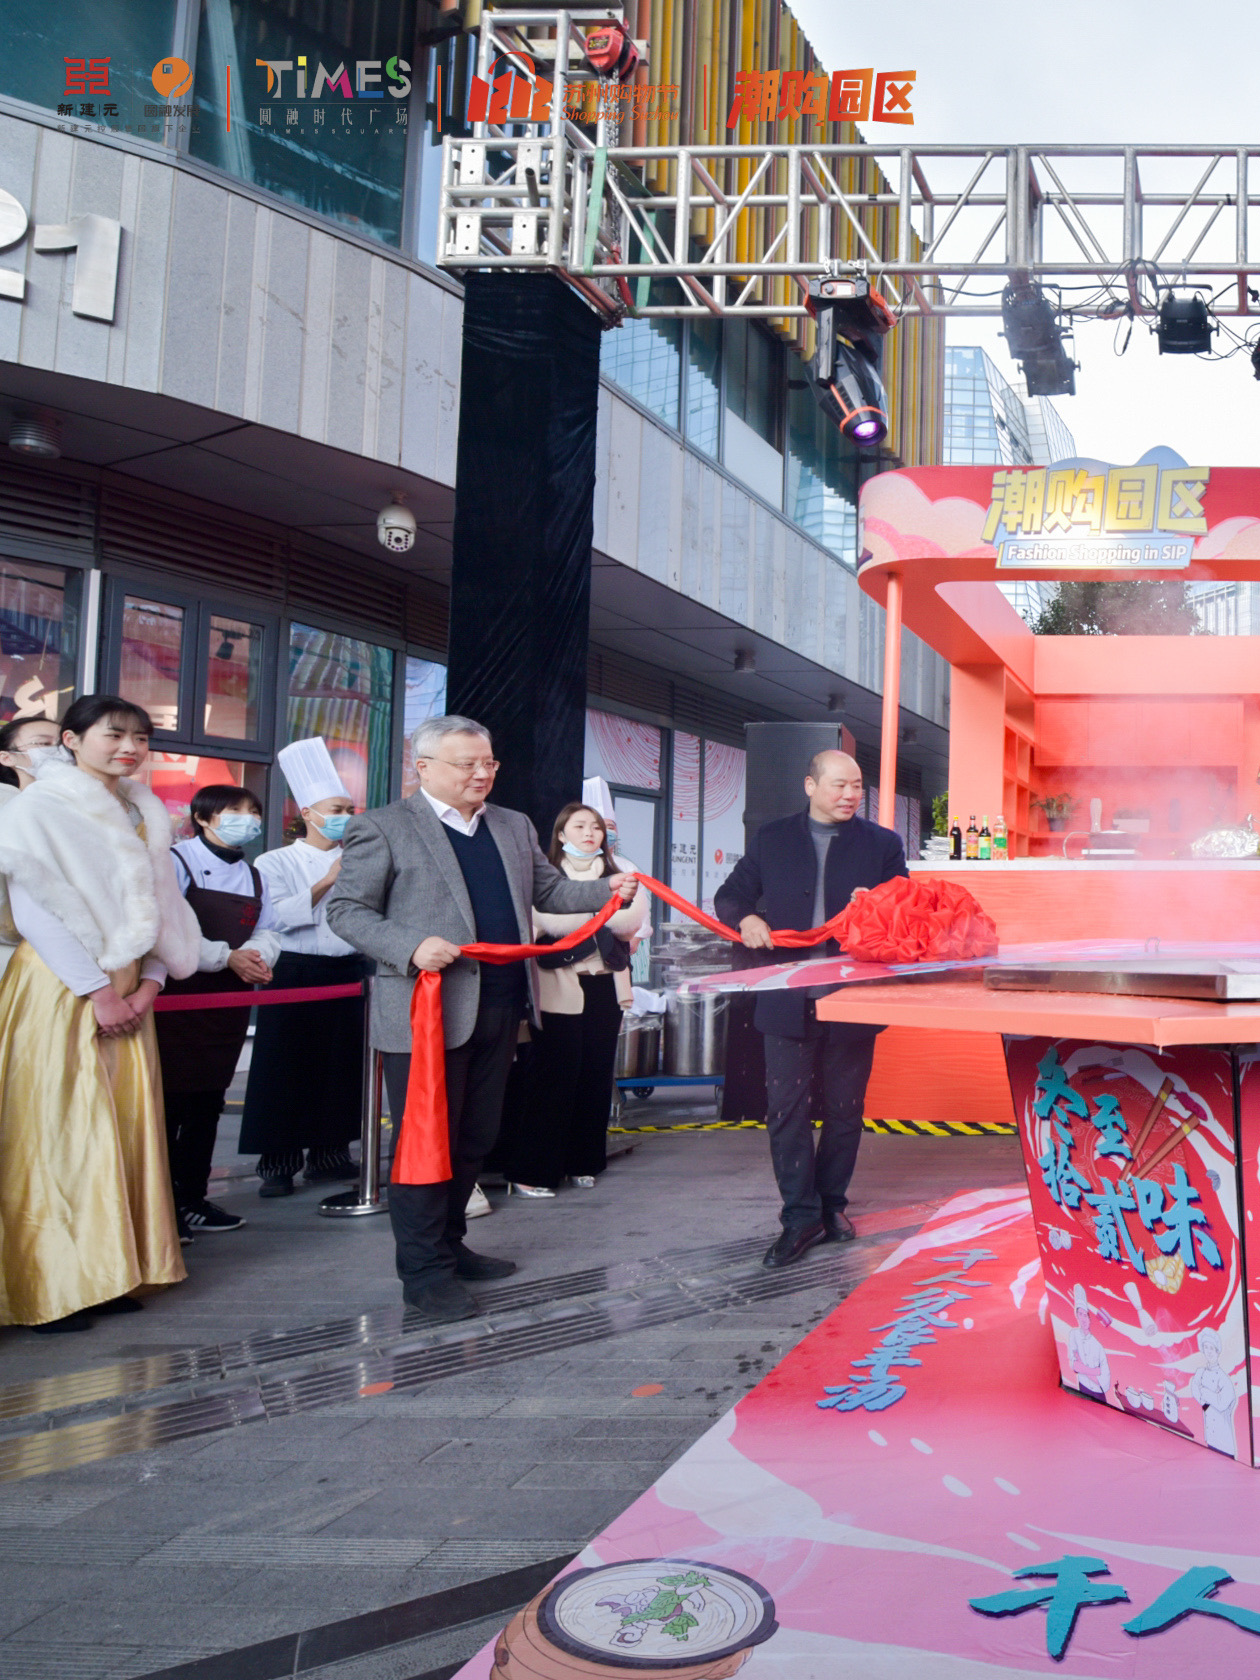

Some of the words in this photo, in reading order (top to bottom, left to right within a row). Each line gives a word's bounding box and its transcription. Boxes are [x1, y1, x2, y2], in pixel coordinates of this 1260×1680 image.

[981, 464, 1210, 544] 潮购园区
[1007, 543, 1067, 561] Fashion
[1069, 543, 1142, 563] Shopping
[1144, 543, 1160, 561] in
[1162, 544, 1187, 561] SIP
[1032, 1045, 1134, 1162] 冬至
[816, 1248, 999, 1412] 千人分食羊汤
